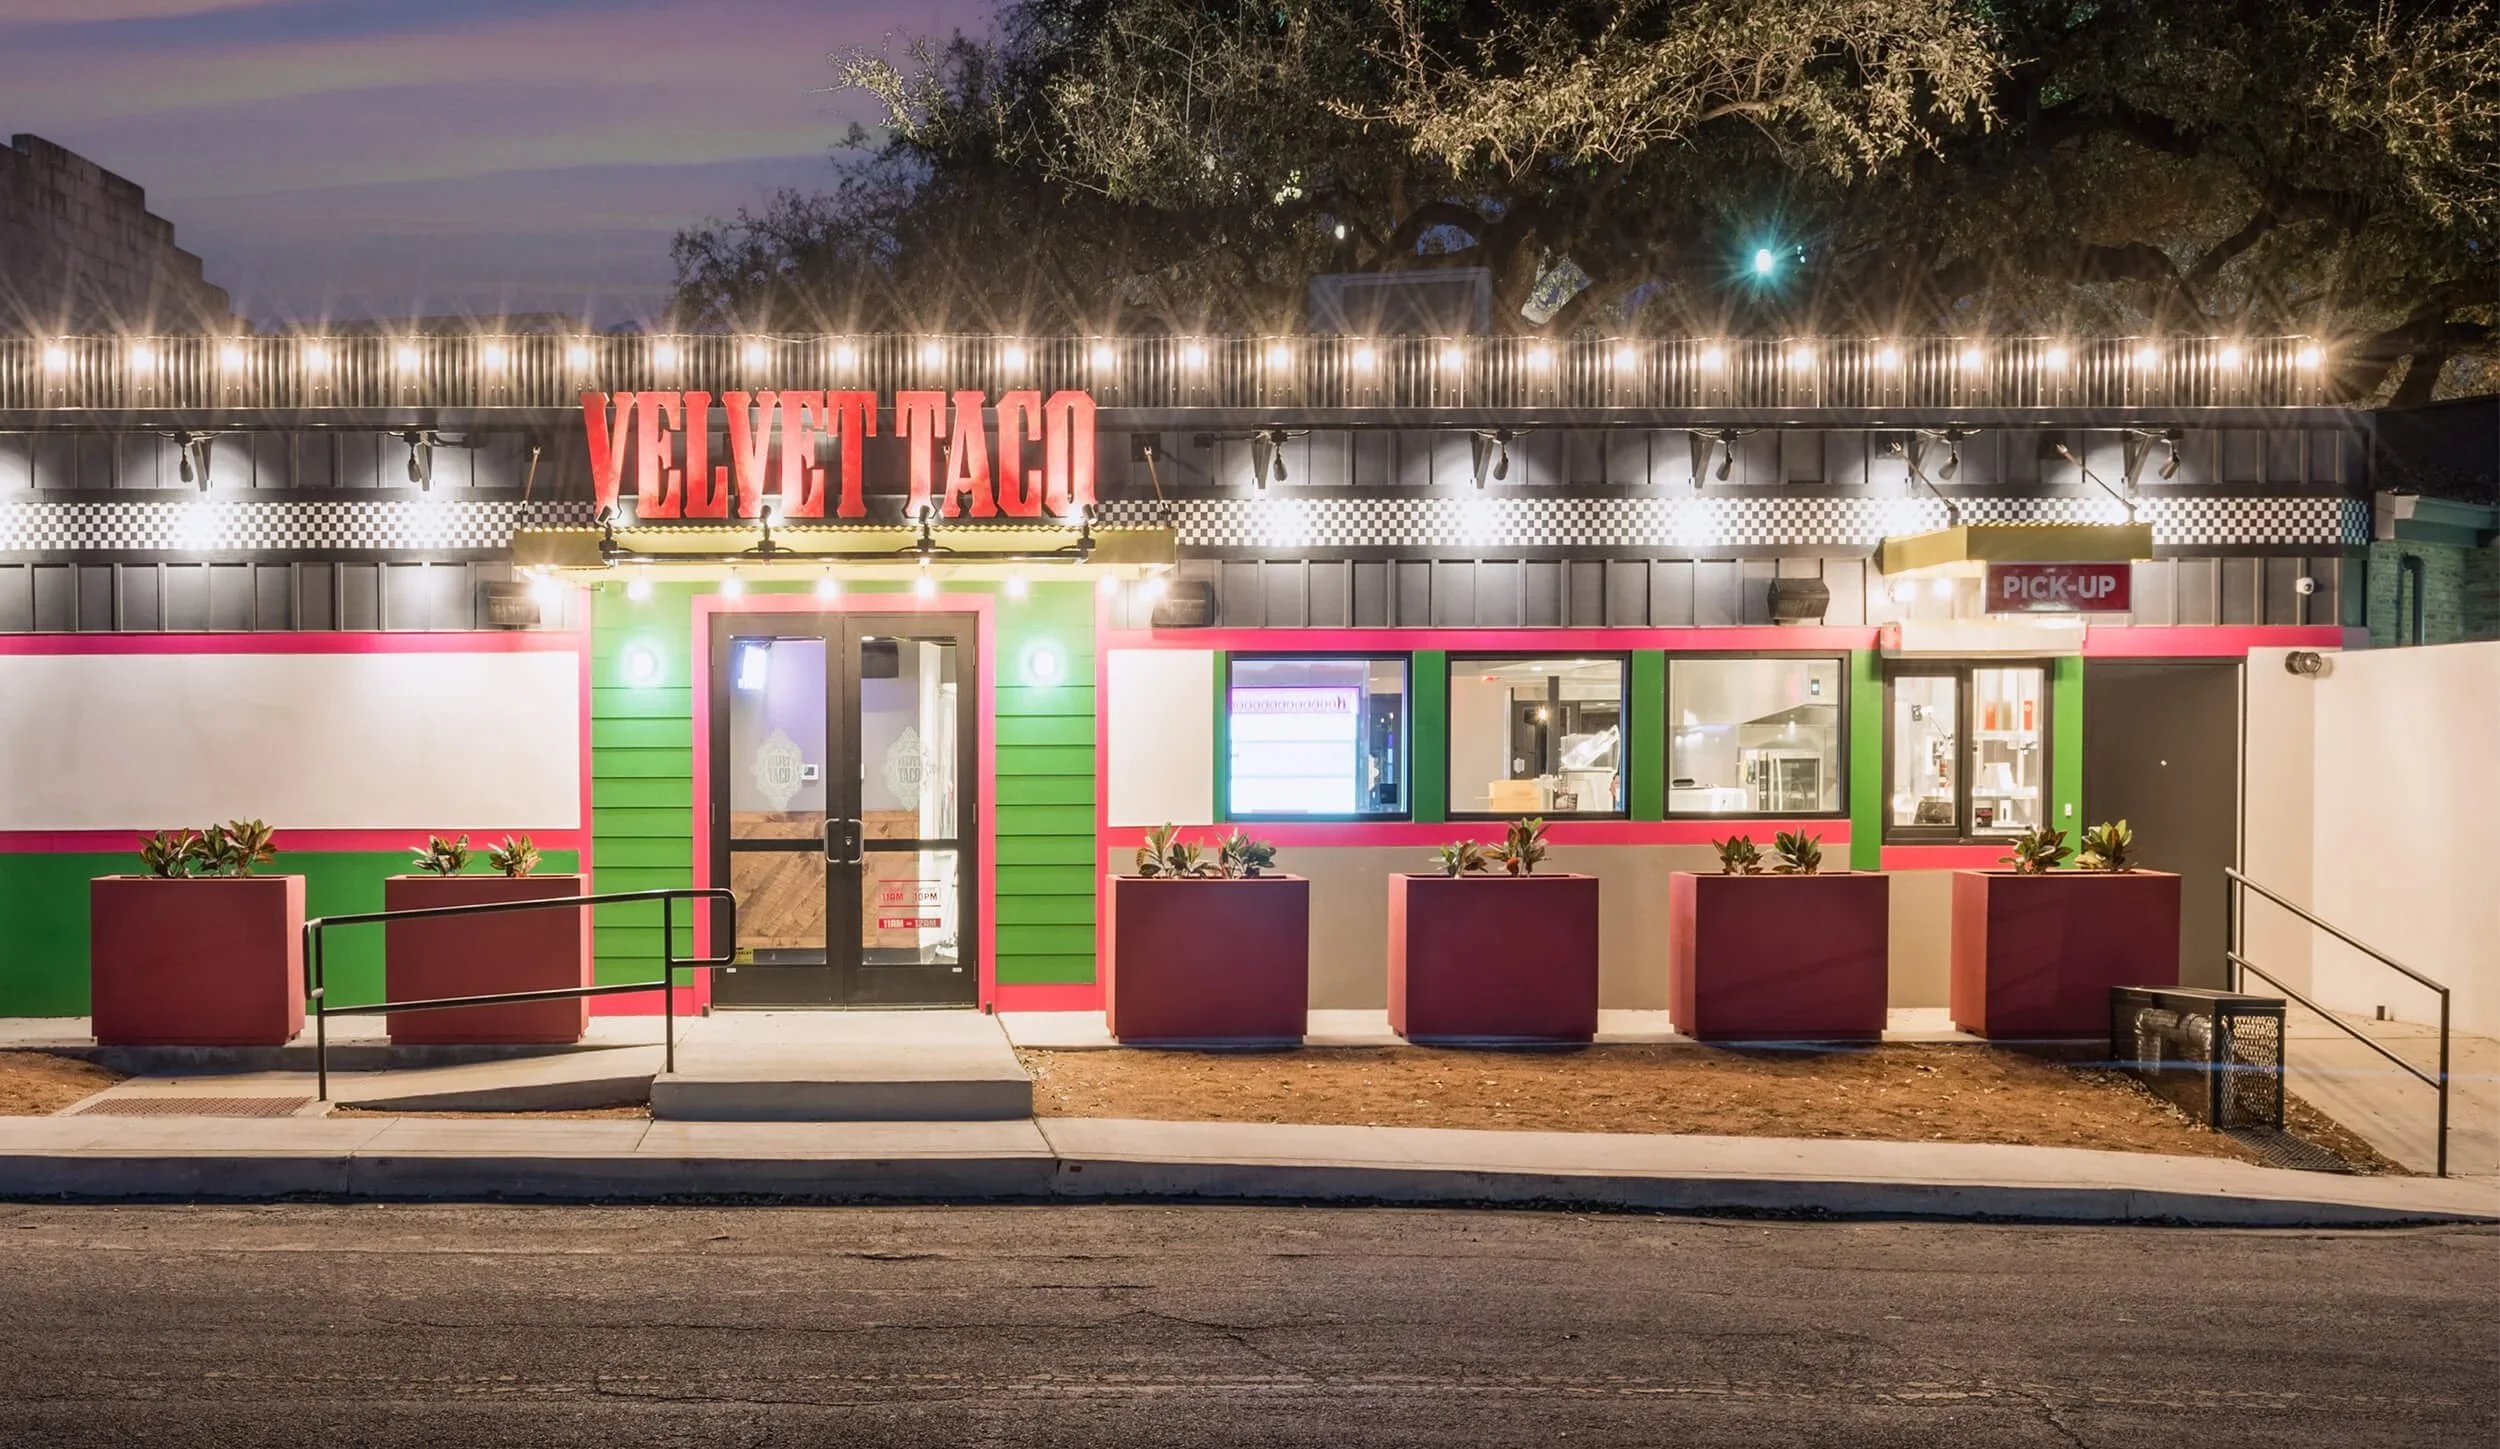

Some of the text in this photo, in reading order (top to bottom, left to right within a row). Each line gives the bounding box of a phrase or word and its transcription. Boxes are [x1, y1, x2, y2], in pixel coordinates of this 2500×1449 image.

[583, 390, 1098, 519] VELVET TACO
[2003, 575, 2116, 599] PICK-UP
